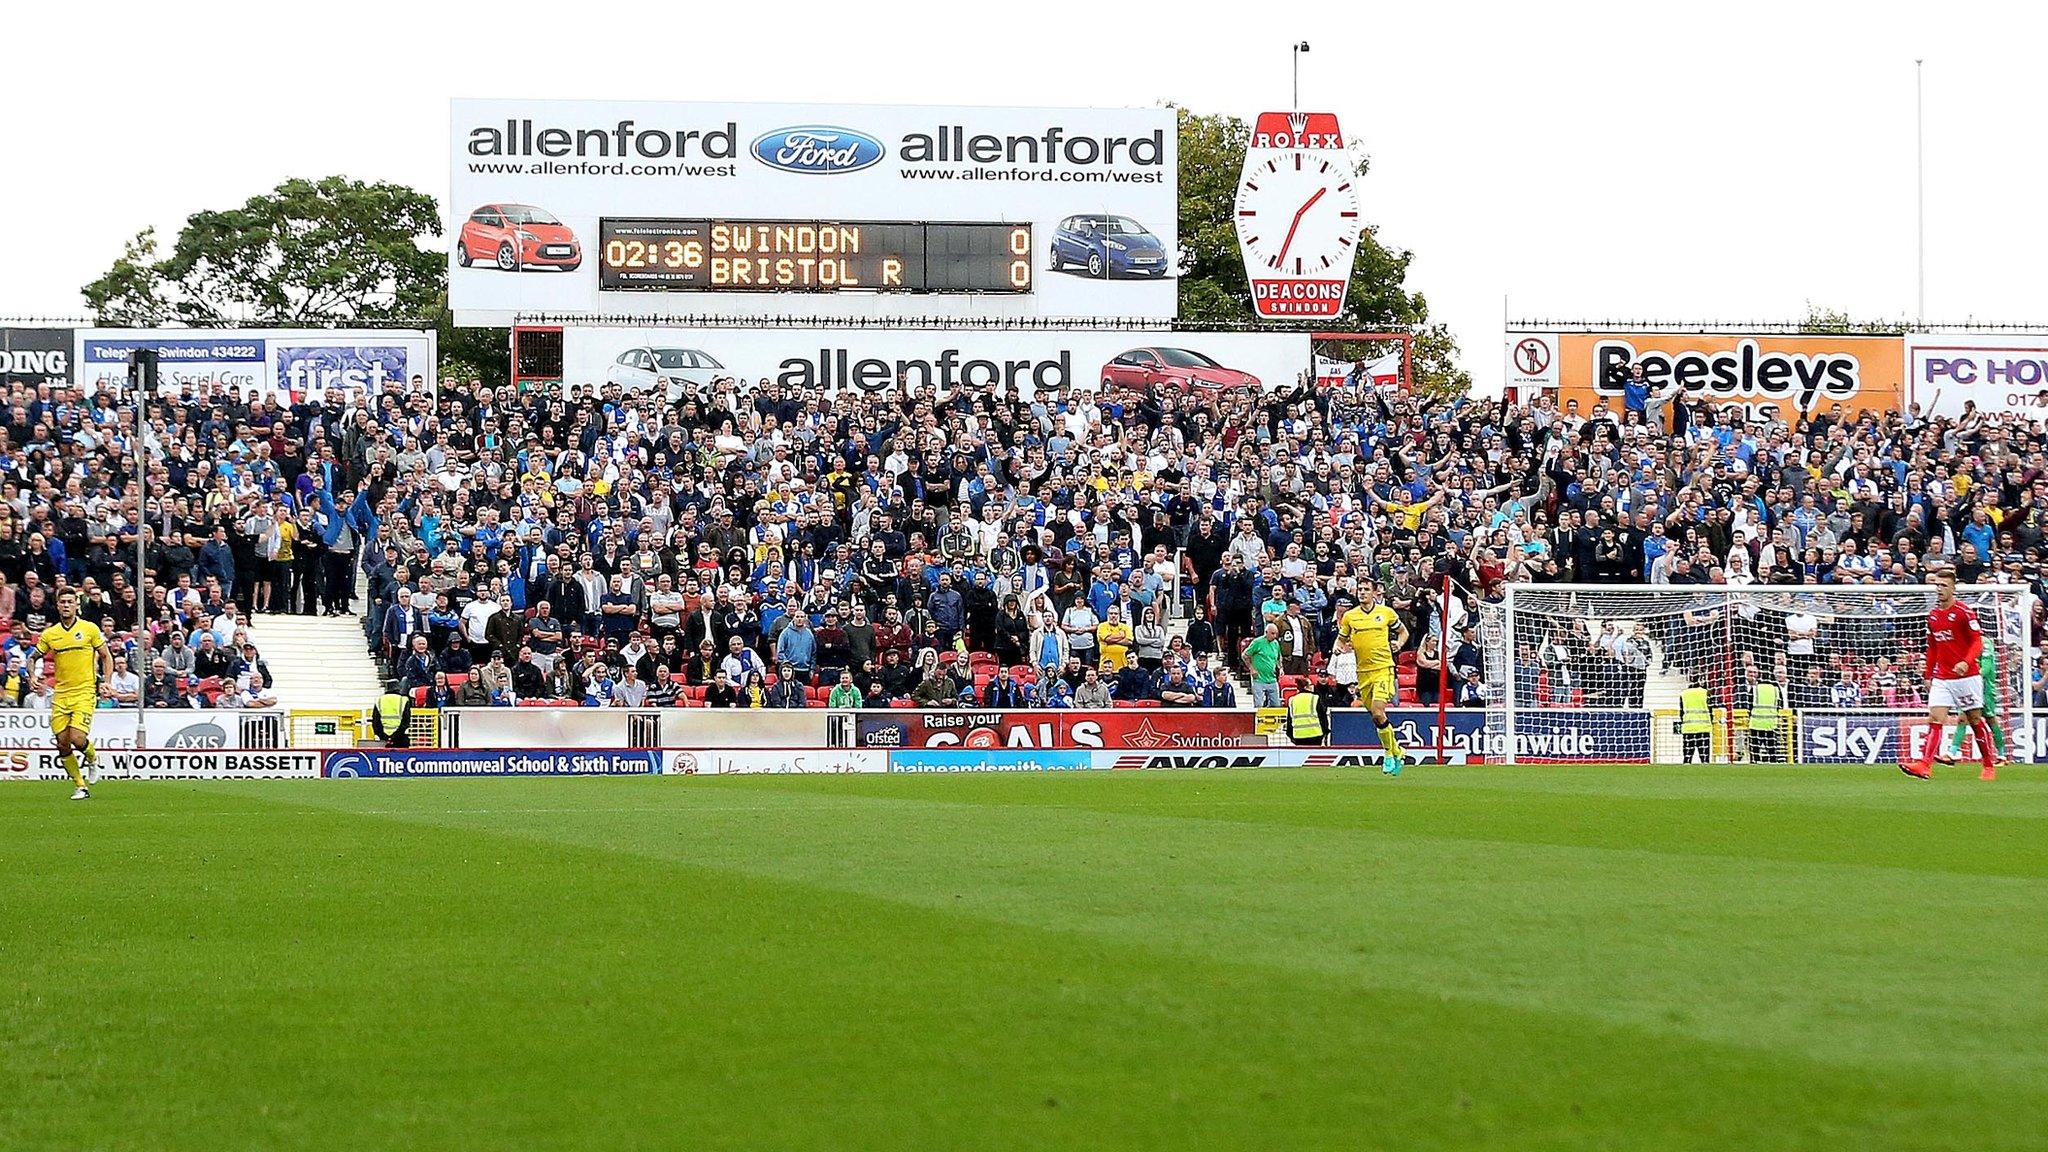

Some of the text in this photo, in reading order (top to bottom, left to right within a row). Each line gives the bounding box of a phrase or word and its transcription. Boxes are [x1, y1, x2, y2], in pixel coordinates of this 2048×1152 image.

[468, 119, 736, 159] allenford
[900, 126, 1163, 165] allenford
[1256, 132, 1339, 149] ROLEX
[776, 132, 858, 167] Ford
[468, 161, 736, 177] www.allenford.com/west
[901, 168, 1163, 184] www.allenford.com/west
[711, 225, 859, 254] SWINDON
[606, 240, 703, 268] 02:36
[711, 257, 858, 285] BRISTOL
[882, 259, 902, 285] R
[1257, 283, 1341, 299] DEACONS
[1271, 302, 1328, 312] SWINDON
[158, 346, 209, 359] Swindon
[211, 346, 256, 358] 434222
[173, 370, 214, 386] Social
[220, 371, 254, 385] Care
[286, 359, 388, 397] first
[777, 349, 1071, 391] allenford
[1600, 345, 1854, 407] Beesleys
[1925, 358, 1978, 384] PC
[924, 713, 1002, 728] Raise your
[174, 733, 219, 748] AXIS
[866, 732, 899, 744] Ofsted
[1172, 733, 1242, 748] Swindon
[1430, 726, 1594, 755] Nationwide
[1812, 717, 1889, 764] sky
[113, 755, 217, 770] WOOTTON
[225, 755, 317, 770] BASSETT
[376, 755, 649, 774] The Commonweal School & Sixth Form
